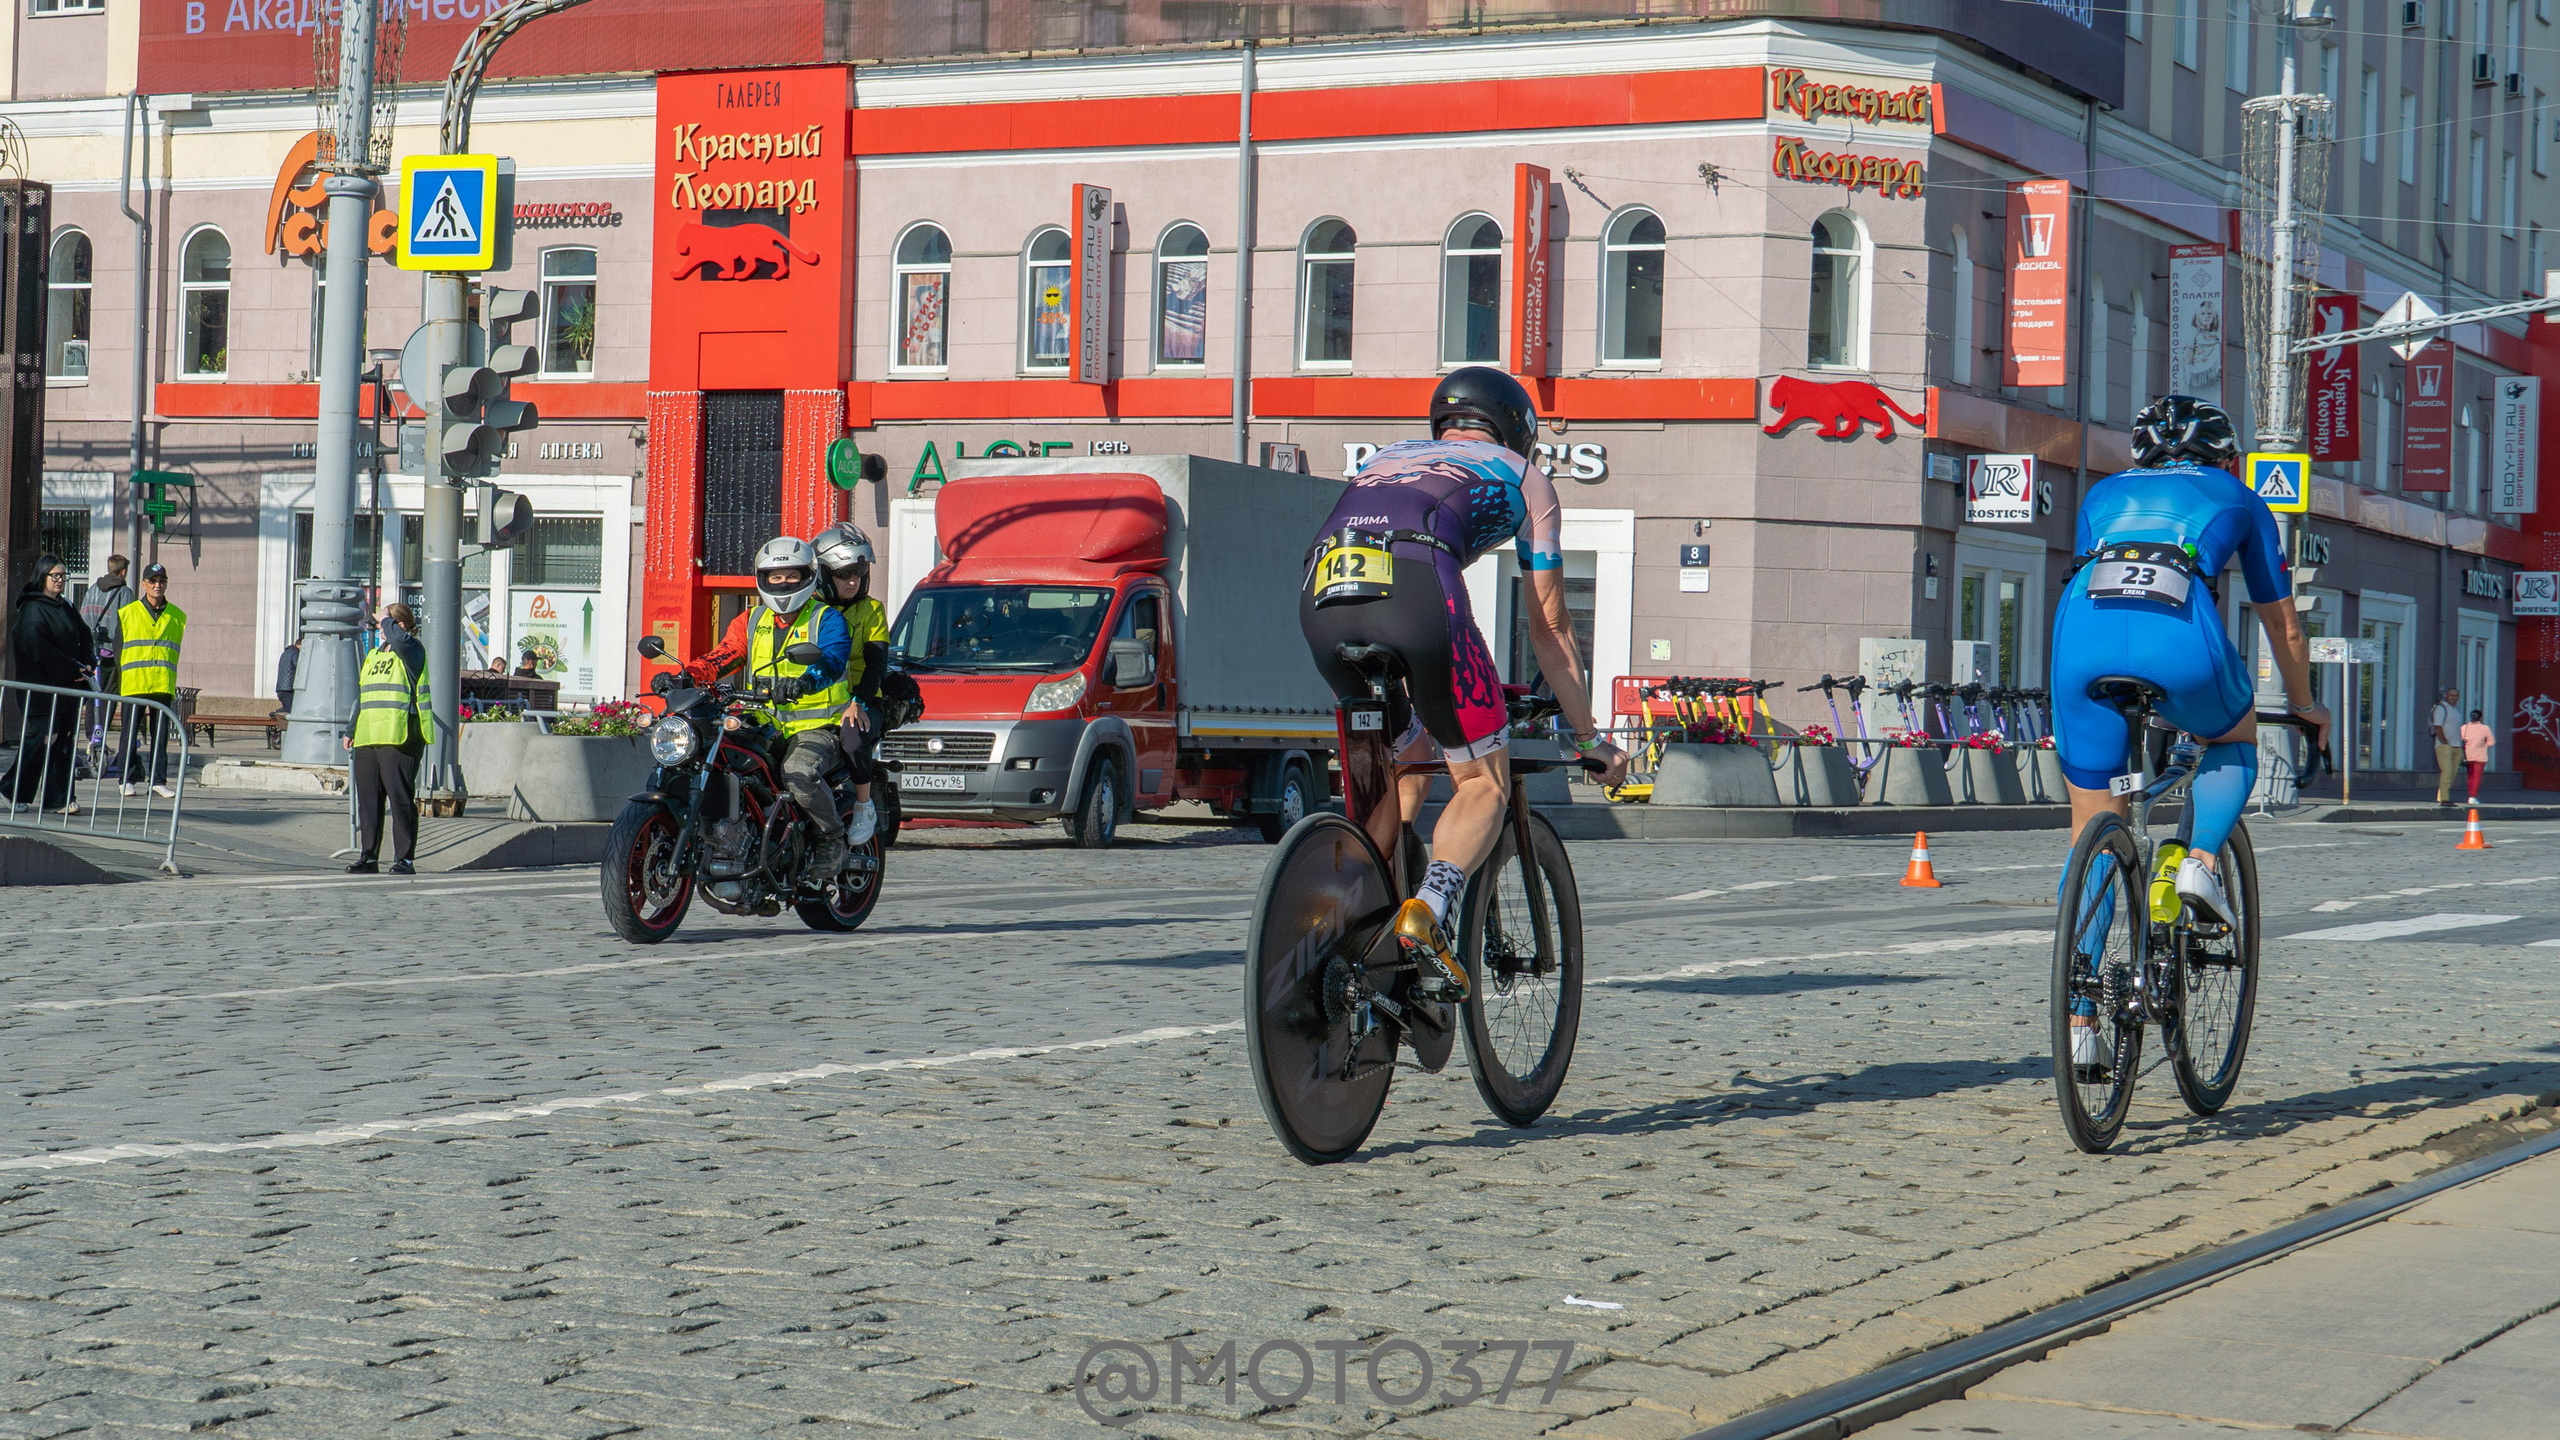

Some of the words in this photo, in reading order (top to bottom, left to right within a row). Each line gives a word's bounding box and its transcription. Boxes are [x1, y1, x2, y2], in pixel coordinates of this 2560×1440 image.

[186, 2, 206, 34] в
[717, 81, 781, 109] ГАЛЕРЕЯ
[1771, 68, 1928, 123] Красный
[673, 123, 823, 170] Красный
[1772, 136, 1926, 198] Леопард
[671, 172, 819, 215] Леопард
[1085, 225, 1095, 379] BODY-PIT.RU
[1534, 260, 1545, 347] Красный
[2182, 291, 2220, 300] ПЛАТКИ
[902, 281, 941, 349] ОПТИКА
[1037, 311, 1067, 324] -50%
[1523, 283, 1536, 367] Леопард
[2011, 310, 2033, 318] игры
[2018, 320, 2054, 329] подарки
[1094, 292, 1102, 379] СПОРТИВНОЕ
[2172, 272, 2180, 396] ПАВЛОВОПОСАДСКИ
[2331, 368, 2351, 437] Красный
[2314, 389, 2334, 455] Леопард
[2518, 404, 2526, 445] ПИТАНИЕ
[541, 443, 603, 459] АПТЕКА
[1096, 441, 1130, 453] сеть
[2503, 404, 2517, 507] BODY-PIT.RU
[837, 460, 859, 474] ALOE
[2516, 448, 2525, 507] СПОРТИВНОЕ
[1346, 515, 1389, 527] ДИМА
[1967, 509, 2030, 518] ROSTIC'S
[1325, 553, 1366, 581] 142
[1690, 546, 1699, 560] 8
[1326, 583, 1359, 595] ДМИТРИЙ
[2121, 566, 2157, 585] 23
[2467, 569, 2502, 599] ROSTIC'S
[530, 594, 557, 618] Рада
[2122, 588, 2146, 596] ЕЛЕНА
[1358, 713, 1370, 727] 142
[951, 776, 961, 785] 96
[2119, 777, 2131, 792] 23
